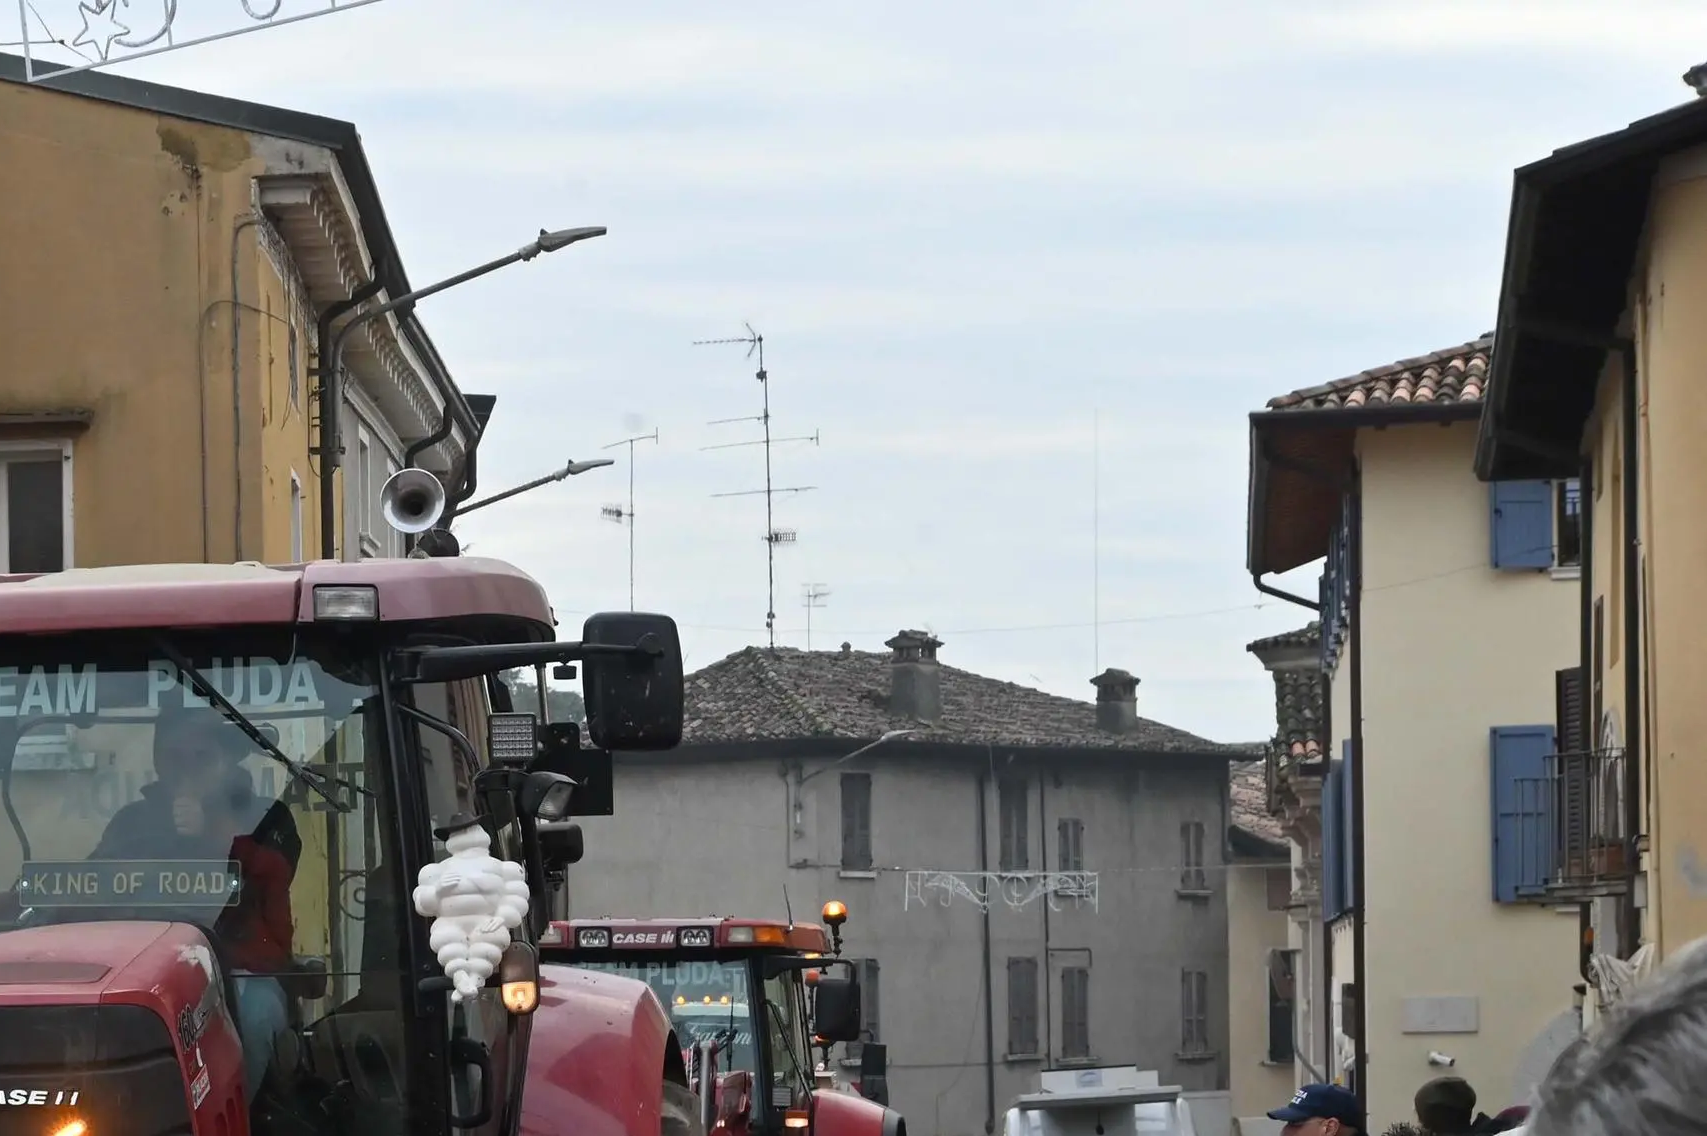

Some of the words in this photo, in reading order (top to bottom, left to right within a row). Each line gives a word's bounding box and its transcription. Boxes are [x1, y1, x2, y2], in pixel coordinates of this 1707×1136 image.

[148, 656, 323, 710] PLUDA
[34, 872, 99, 895] KING
[113, 872, 144, 894] OF
[159, 871, 225, 894] ROAD
[612, 933, 658, 944] CASE
[646, 960, 724, 986] PLUDA
